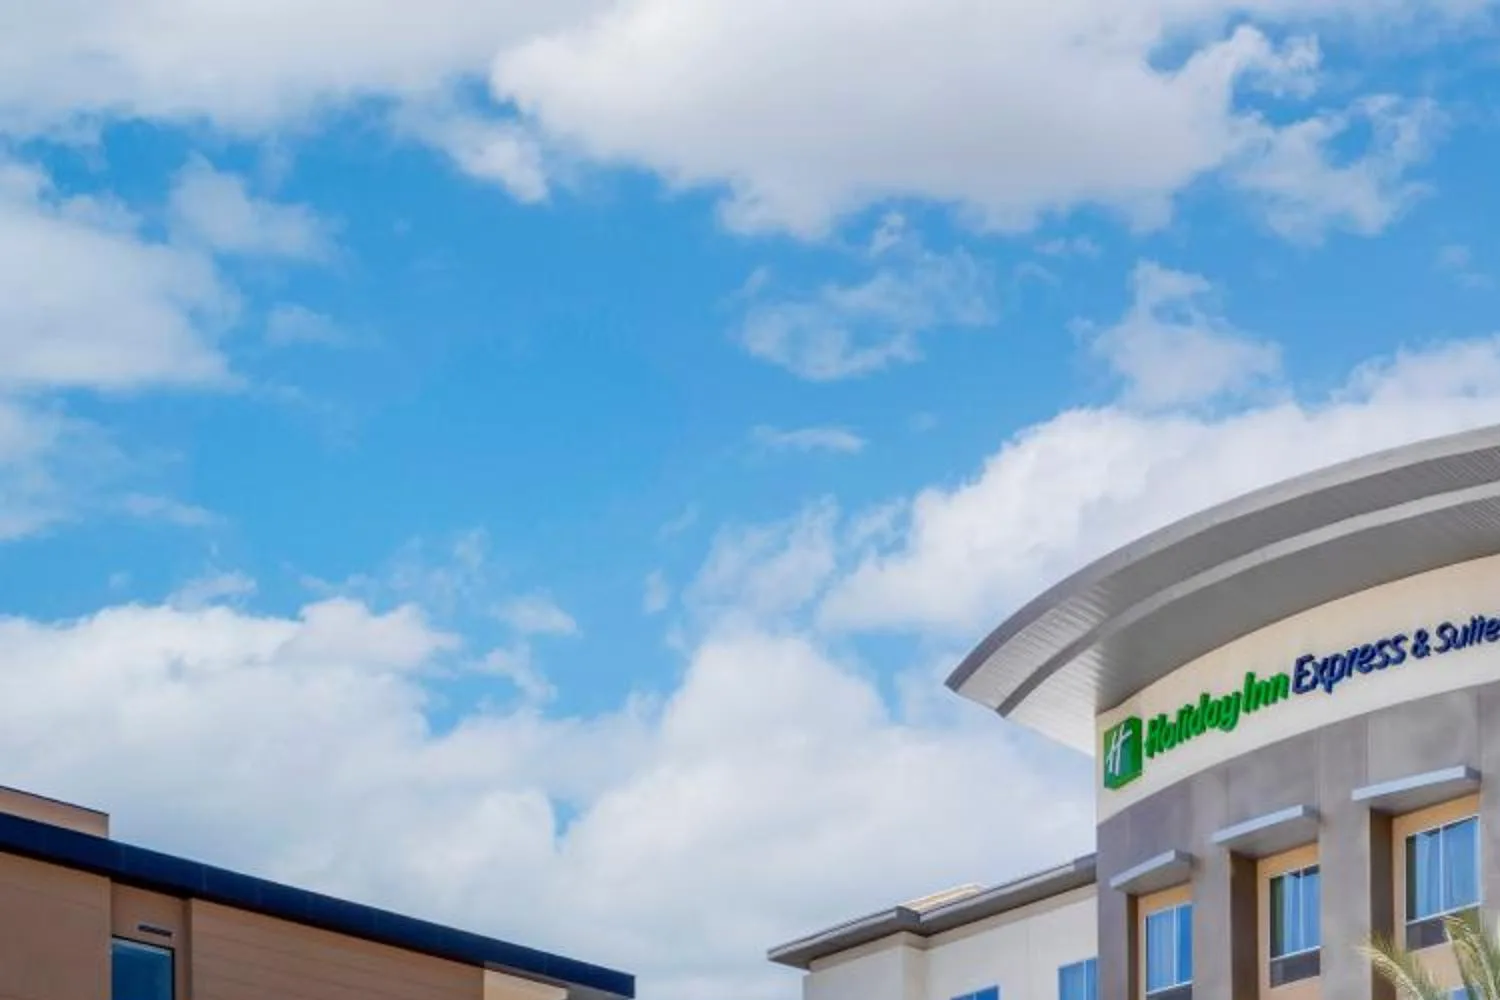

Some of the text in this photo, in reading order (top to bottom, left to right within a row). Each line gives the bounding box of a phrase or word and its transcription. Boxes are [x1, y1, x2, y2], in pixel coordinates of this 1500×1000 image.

[1144, 690, 1241, 758] Holiday
[1242, 672, 1289, 714] Inn
[1292, 629, 1408, 695] Express
[1410, 627, 1431, 659] &
